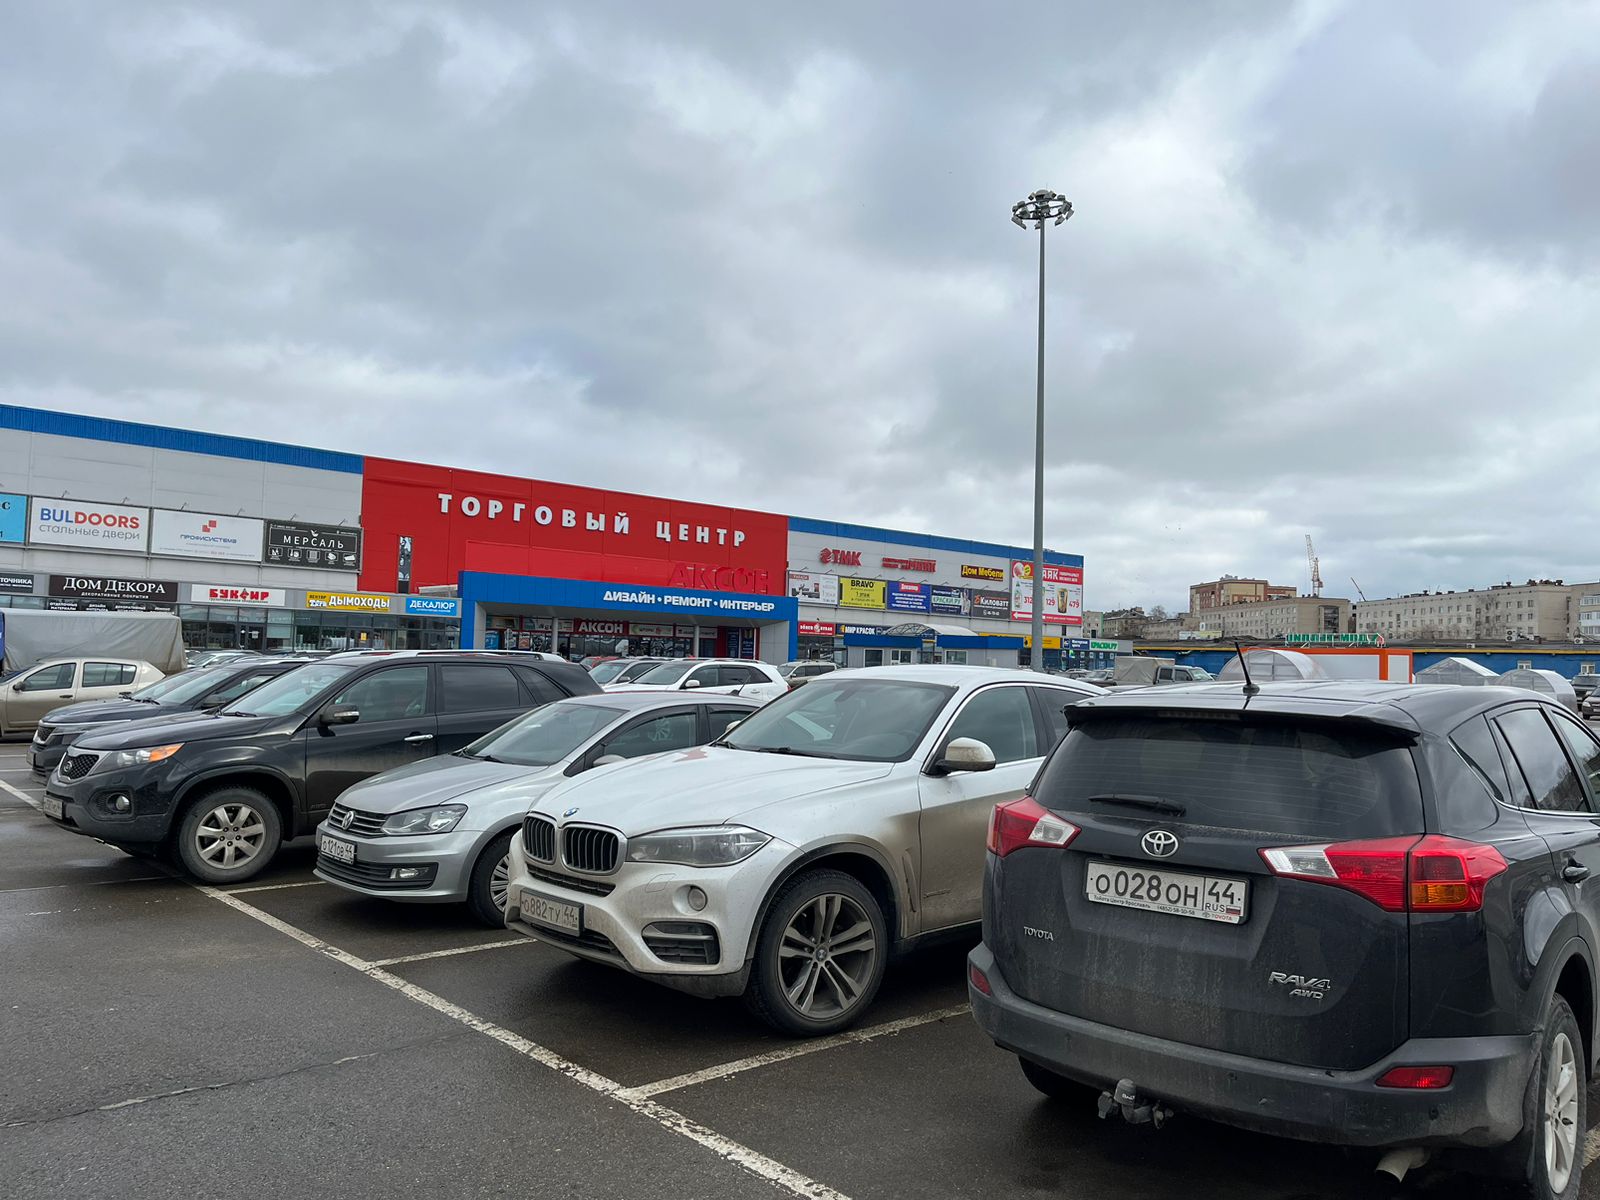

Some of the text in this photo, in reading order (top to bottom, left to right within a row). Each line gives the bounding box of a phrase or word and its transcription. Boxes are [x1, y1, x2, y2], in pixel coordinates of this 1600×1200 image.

[40, 508, 140, 529] BULDOORS
[437, 493, 746, 547] ТОРГОВЫЙ ЦЕНТР
[39, 524, 140, 540] стальные двери
[283, 535, 344, 549] МЕРСАЛЬ
[62, 577, 166, 594] ДОМ ДЕКОРА
[667, 563, 769, 595] АКСОН
[850, 580, 874, 589] BRAVO
[328, 595, 390, 609] ДЫМОХОДЫ
[409, 600, 456, 609] ДЕКАЛЮР
[603, 590, 775, 612] ДИЗАЙН РЕМОНТ ИНТЕРЬЕР
[578, 621, 624, 634] АКСОН
[856, 627, 876, 635] КРАСОК
[1207, 880, 1236, 905] 44
[1204, 902, 1226, 913] RUS
[1211, 913, 1233, 922] TOYOTA
[1023, 926, 1054, 941] TOYOTA
[1267, 971, 1331, 991] RAV4
[1289, 988, 1324, 999] AWD
